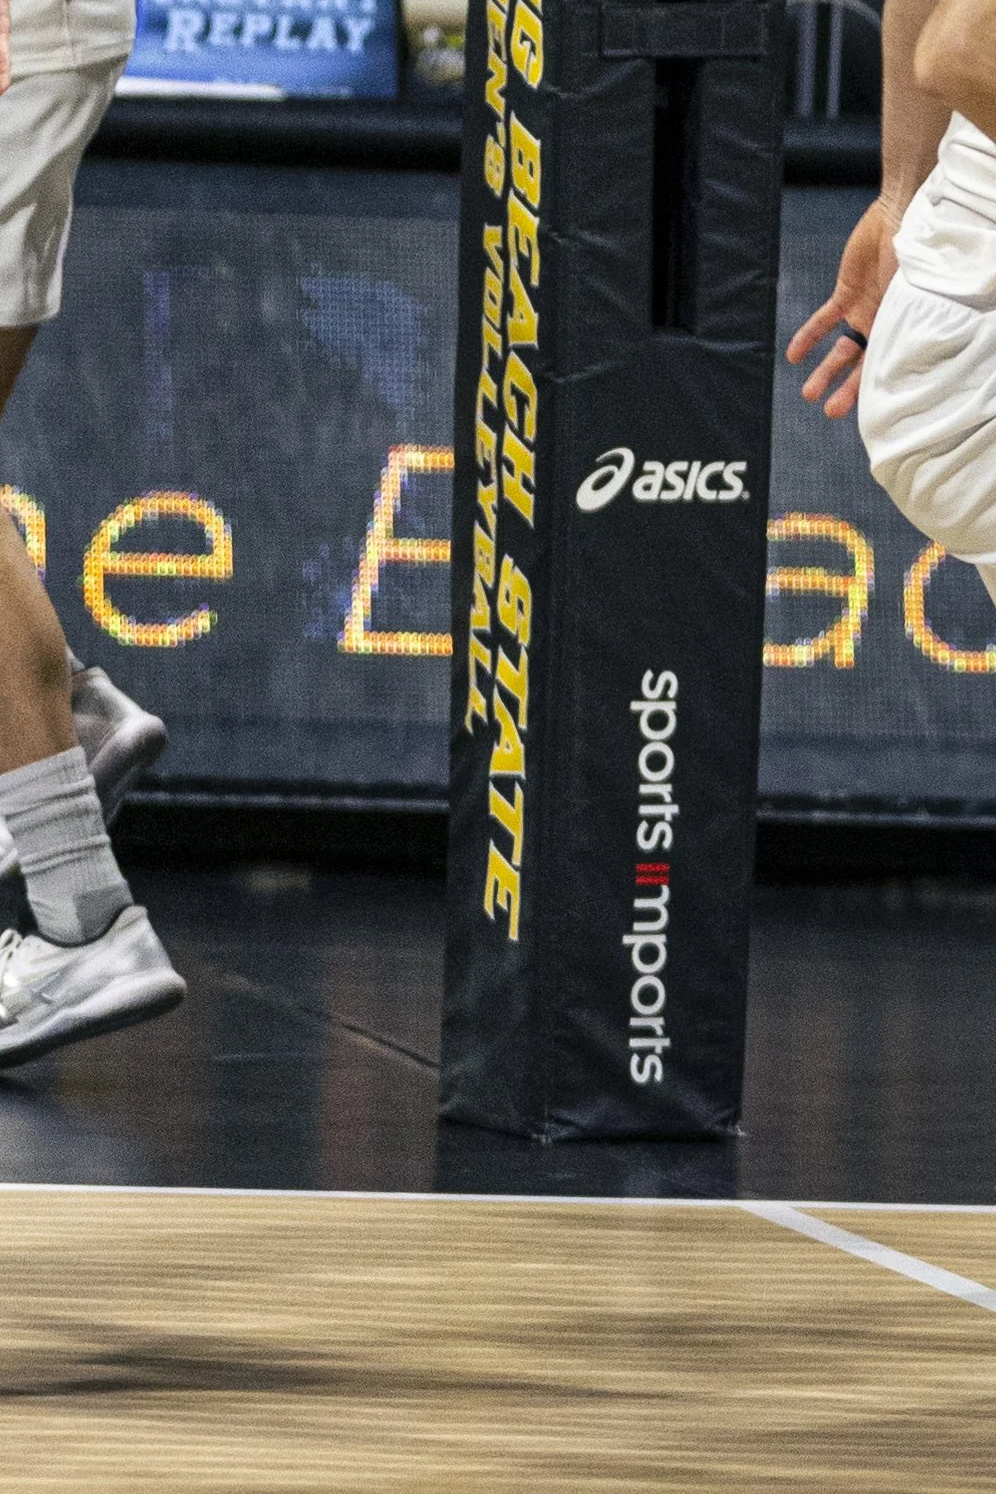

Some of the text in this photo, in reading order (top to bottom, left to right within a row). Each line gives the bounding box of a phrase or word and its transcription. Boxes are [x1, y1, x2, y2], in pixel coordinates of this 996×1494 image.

[465, 223, 504, 734] VOLLEYBALL
[503, 110, 541, 528] BEACH
[484, 553, 531, 942] STATE
[630, 669, 680, 853] sports
